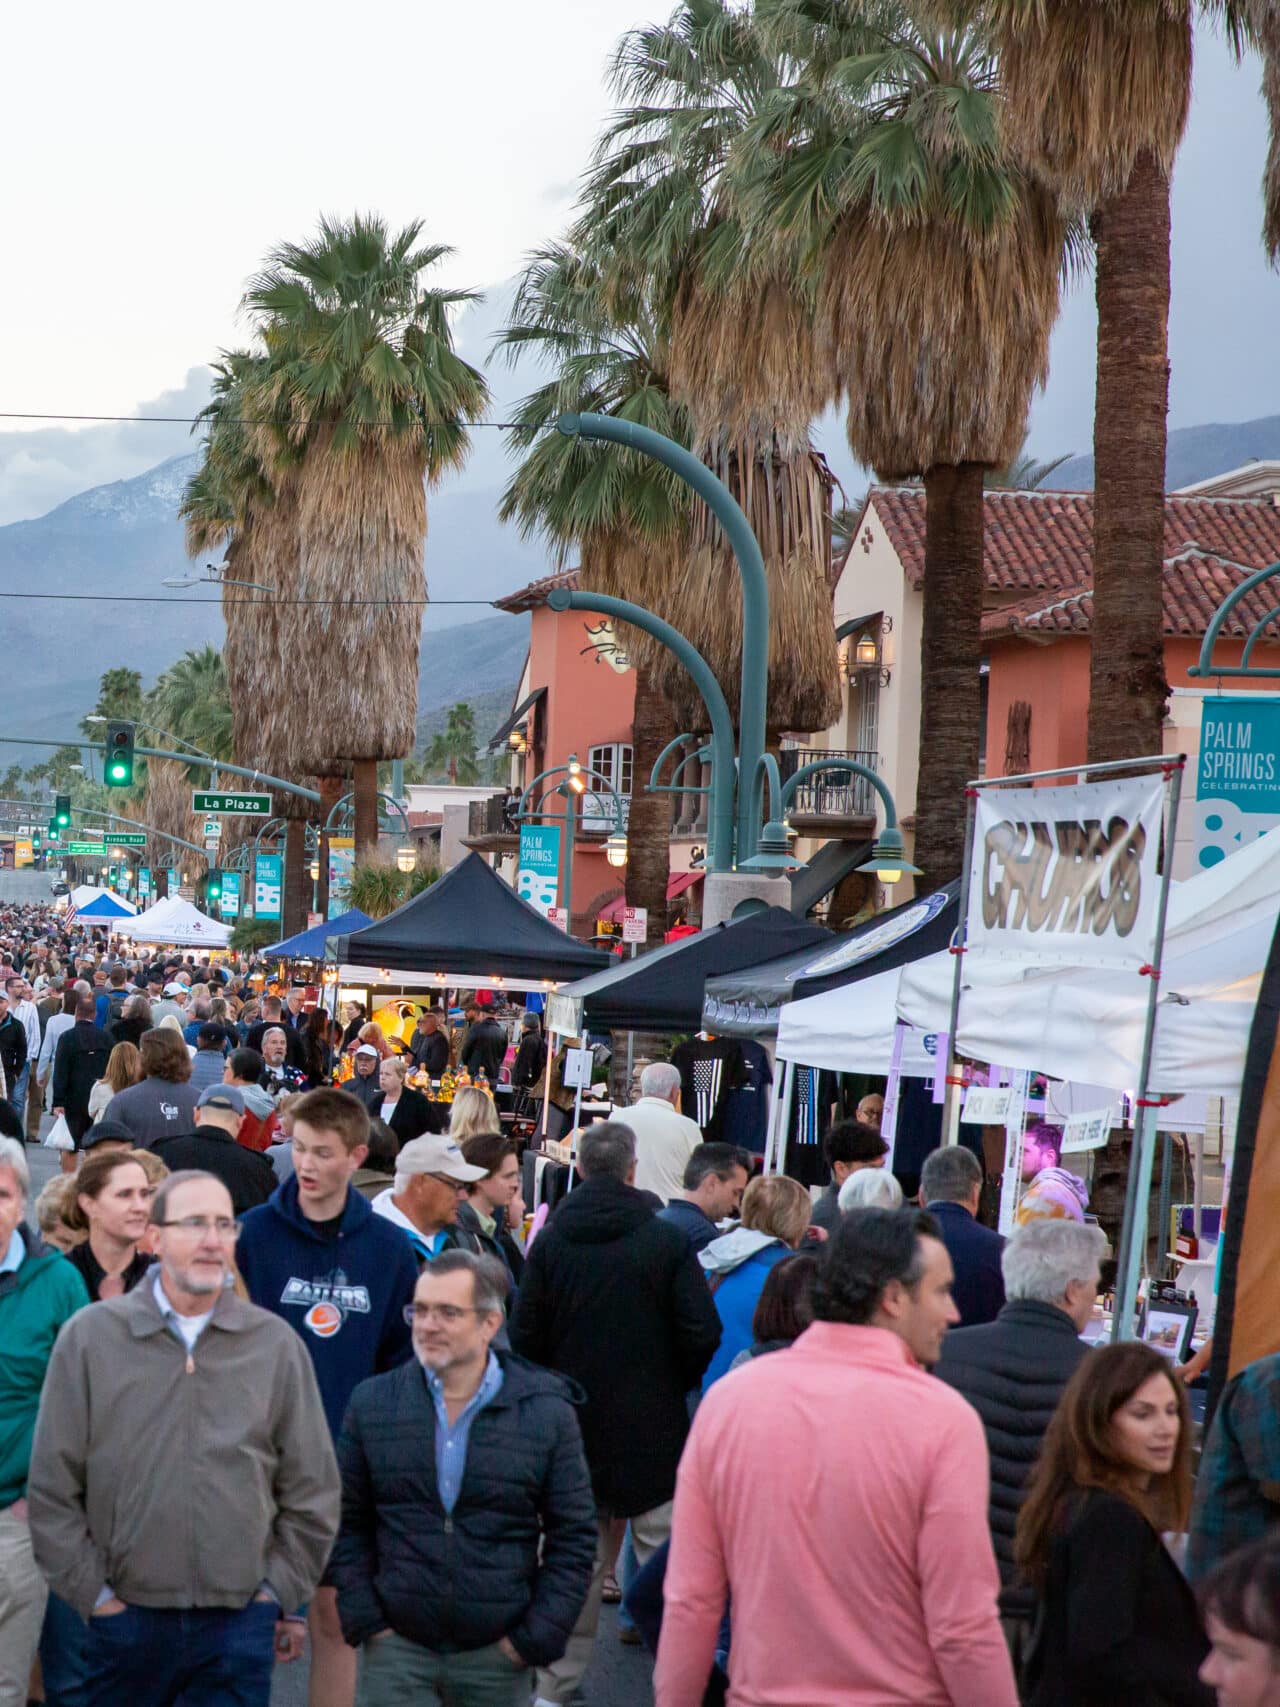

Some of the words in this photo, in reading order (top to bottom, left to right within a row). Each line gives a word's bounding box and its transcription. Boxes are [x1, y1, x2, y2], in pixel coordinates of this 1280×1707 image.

[1204, 721, 1252, 749] PALM
[1202, 752, 1276, 780] SPRINGS
[204, 798, 219, 809] La
[225, 799, 260, 810] Plaza
[205, 824, 214, 834] P
[522, 836, 542, 848] PALM
[522, 849, 552, 862] SPRINGS
[624, 909, 634, 918] NO
